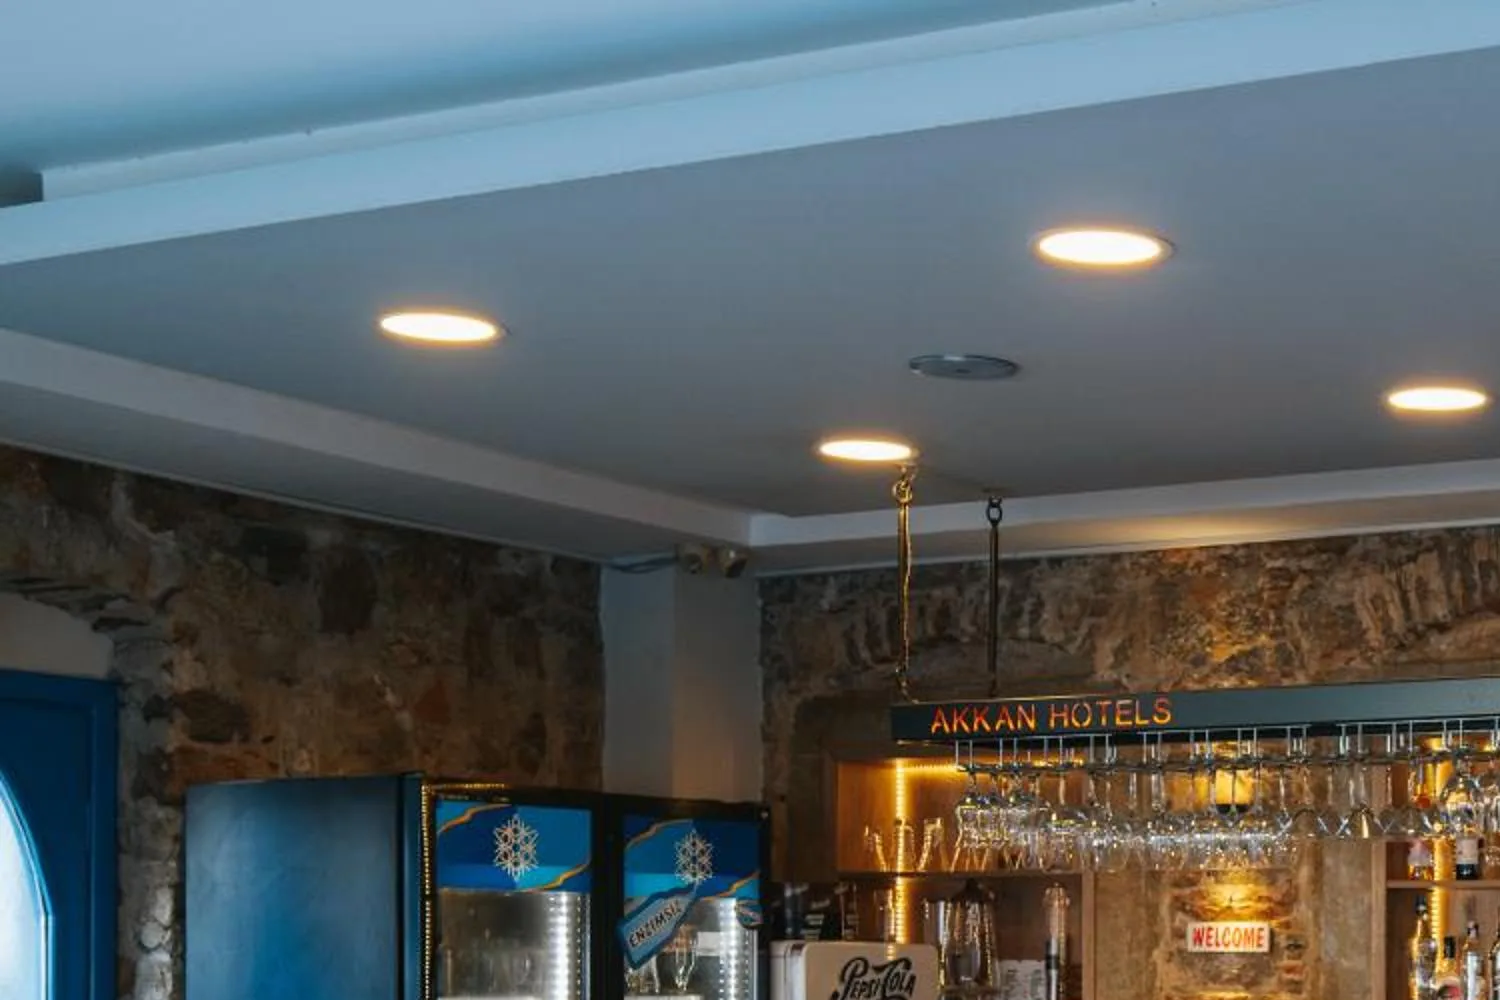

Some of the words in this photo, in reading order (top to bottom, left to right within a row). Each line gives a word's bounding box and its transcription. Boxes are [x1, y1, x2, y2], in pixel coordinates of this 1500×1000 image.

[931, 703, 1037, 734] AKKAN
[1050, 697, 1172, 729] HOTELS
[1193, 926, 1265, 947] WELCOME
